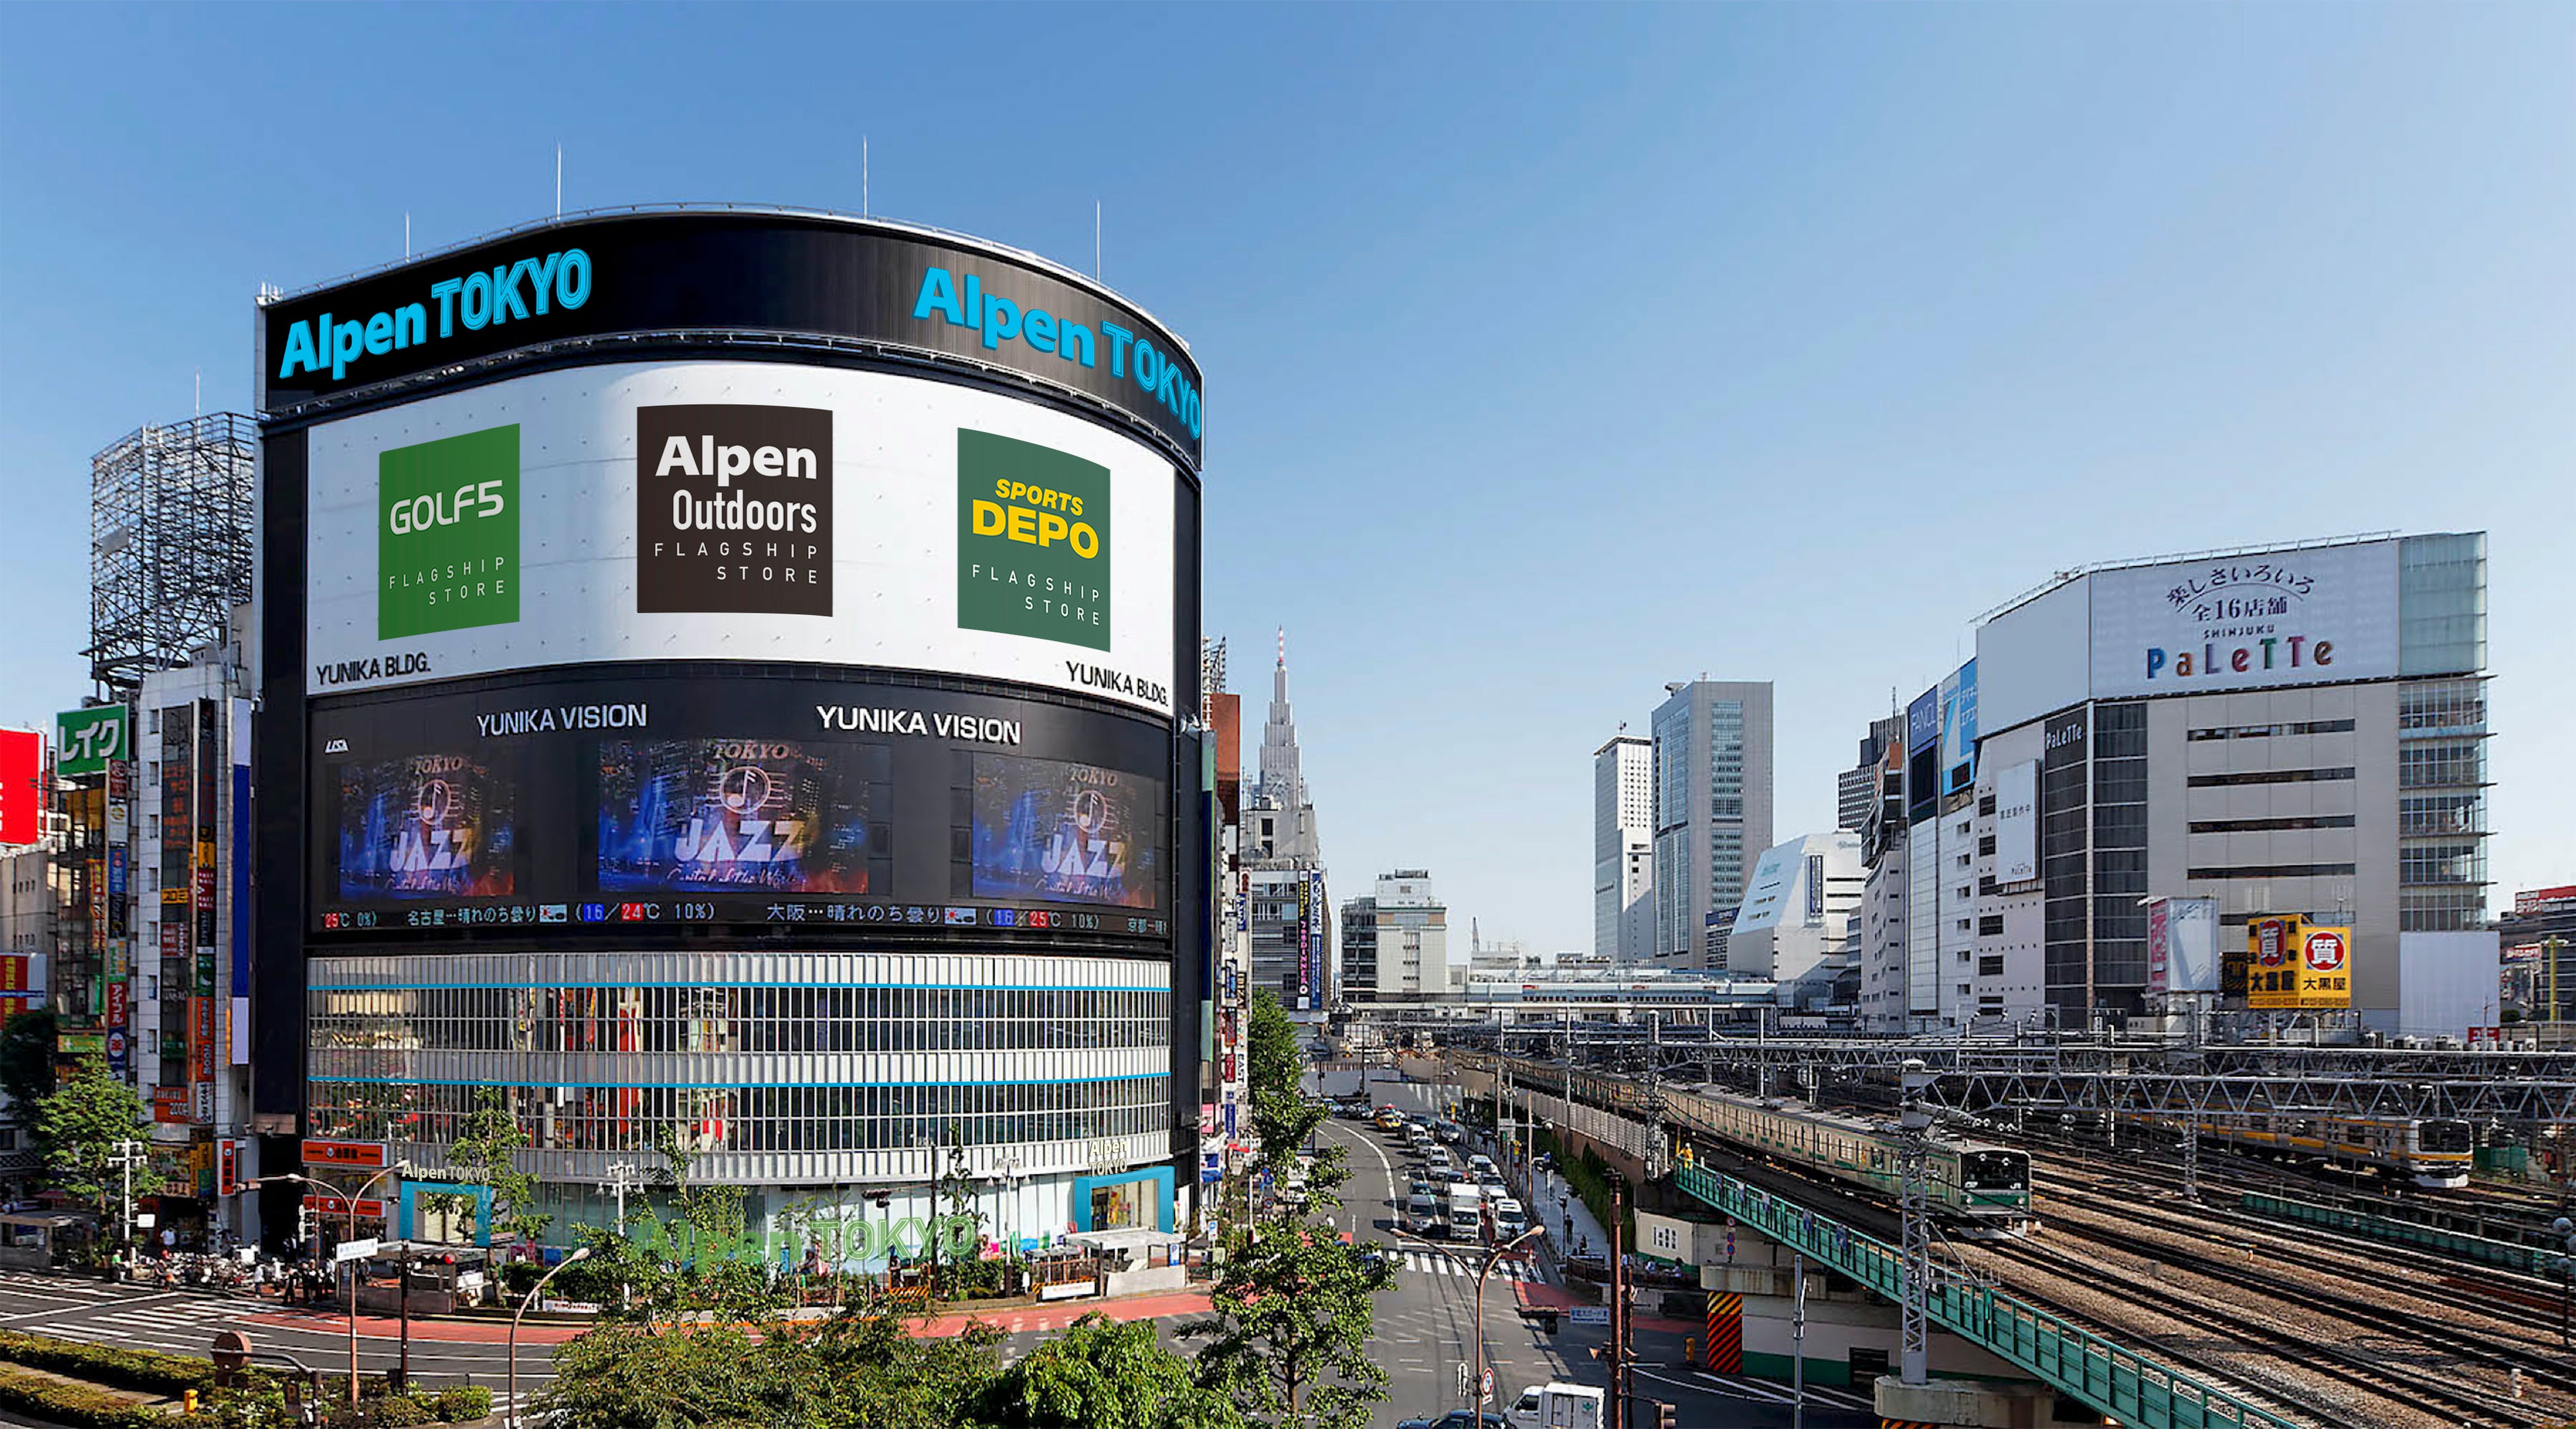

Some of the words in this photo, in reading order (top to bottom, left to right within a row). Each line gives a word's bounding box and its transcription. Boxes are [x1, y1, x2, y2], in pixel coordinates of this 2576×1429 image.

[279, 302, 427, 381] Alpen
[431, 248, 592, 339] TOKYO
[911, 267, 1094, 369] Alpen
[1100, 320, 1201, 440] TOKYO
[655, 435, 818, 487] Alpen
[389, 479, 504, 536] GOLF5
[672, 489, 818, 533] Outdoors
[995, 479, 1083, 516] SPORTS
[972, 499, 1099, 559] DEPO
[655, 542, 818, 559] FLAGSHIP
[389, 557, 504, 589] FLAGSHIP
[717, 567, 818, 584] STORE
[973, 565, 1099, 602] FLAGSHIP
[2166, 564, 2314, 607] 楽しさいろいろ
[429, 580, 503, 605] STORE
[2192, 596, 2287, 621] 全16店舗
[1025, 597, 1099, 625] STORE
[2203, 624, 2275, 639] SHINJUKU
[316, 658, 381, 686] YUNIKA
[386, 652, 431, 678] BLDG.
[1066, 661, 1134, 695] YUNIKA
[1137, 681, 1168, 707] BLDG.
[477, 710, 555, 737] YUNIKA
[559, 704, 647, 730] VISION
[816, 705, 927, 736] YUNIKA
[933, 712, 1021, 744] VISION
[59, 718, 119, 761] レイク
[714, 743, 790, 759] TOKYO
[414, 757, 462, 773] TOKYO
[1069, 767, 1118, 786] TOKYO
[390, 827, 472, 872] JAZZ
[675, 818, 806, 862] JAZZ
[1041, 834, 1126, 878] JAZZ
[2262, 926, 2279, 958] 質
[2310, 939, 2338, 965] 質
[2303, 977, 2346, 991] 大黒屋
[112, 985, 123, 1023] アイフル
[1089, 1140, 1127, 1158] Alpen
[402, 1164, 447, 1181] Alpen
[448, 1166, 490, 1181] TOKYO
[1090, 1158, 1127, 1177] TOKYO
[811, 1215, 976, 1261] TOKYO
